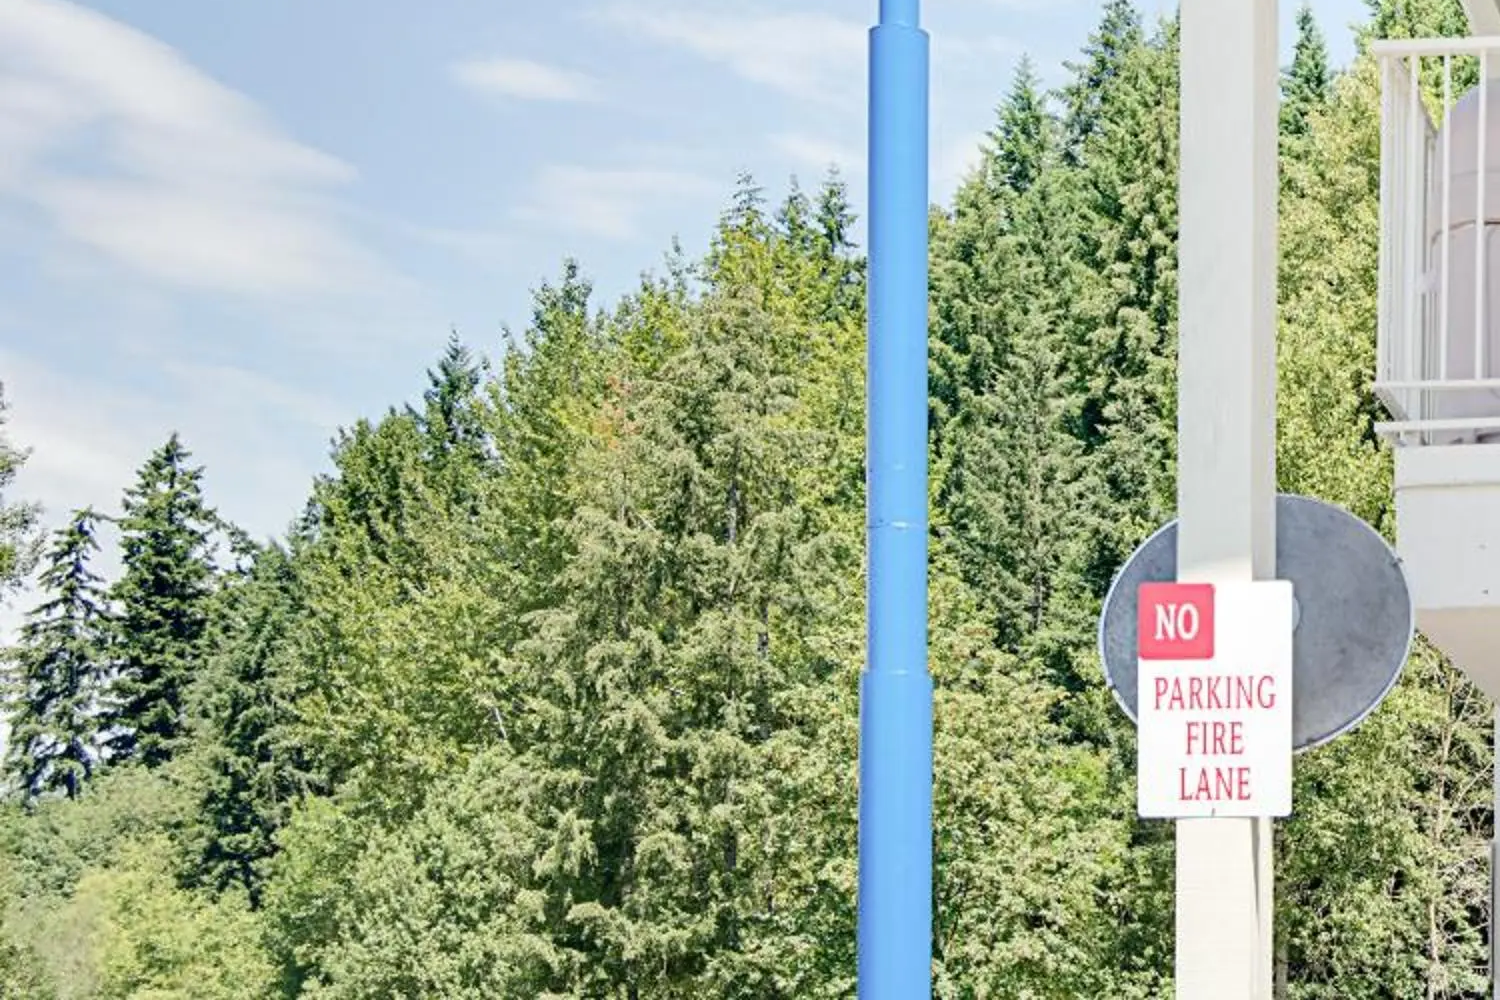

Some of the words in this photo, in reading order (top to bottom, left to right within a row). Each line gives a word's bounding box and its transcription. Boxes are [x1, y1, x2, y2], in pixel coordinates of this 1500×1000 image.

[1154, 602, 1200, 640] NO
[1153, 675, 1277, 711] PARKING
[1185, 721, 1245, 756] FIRE
[1178, 767, 1252, 801] LANE
